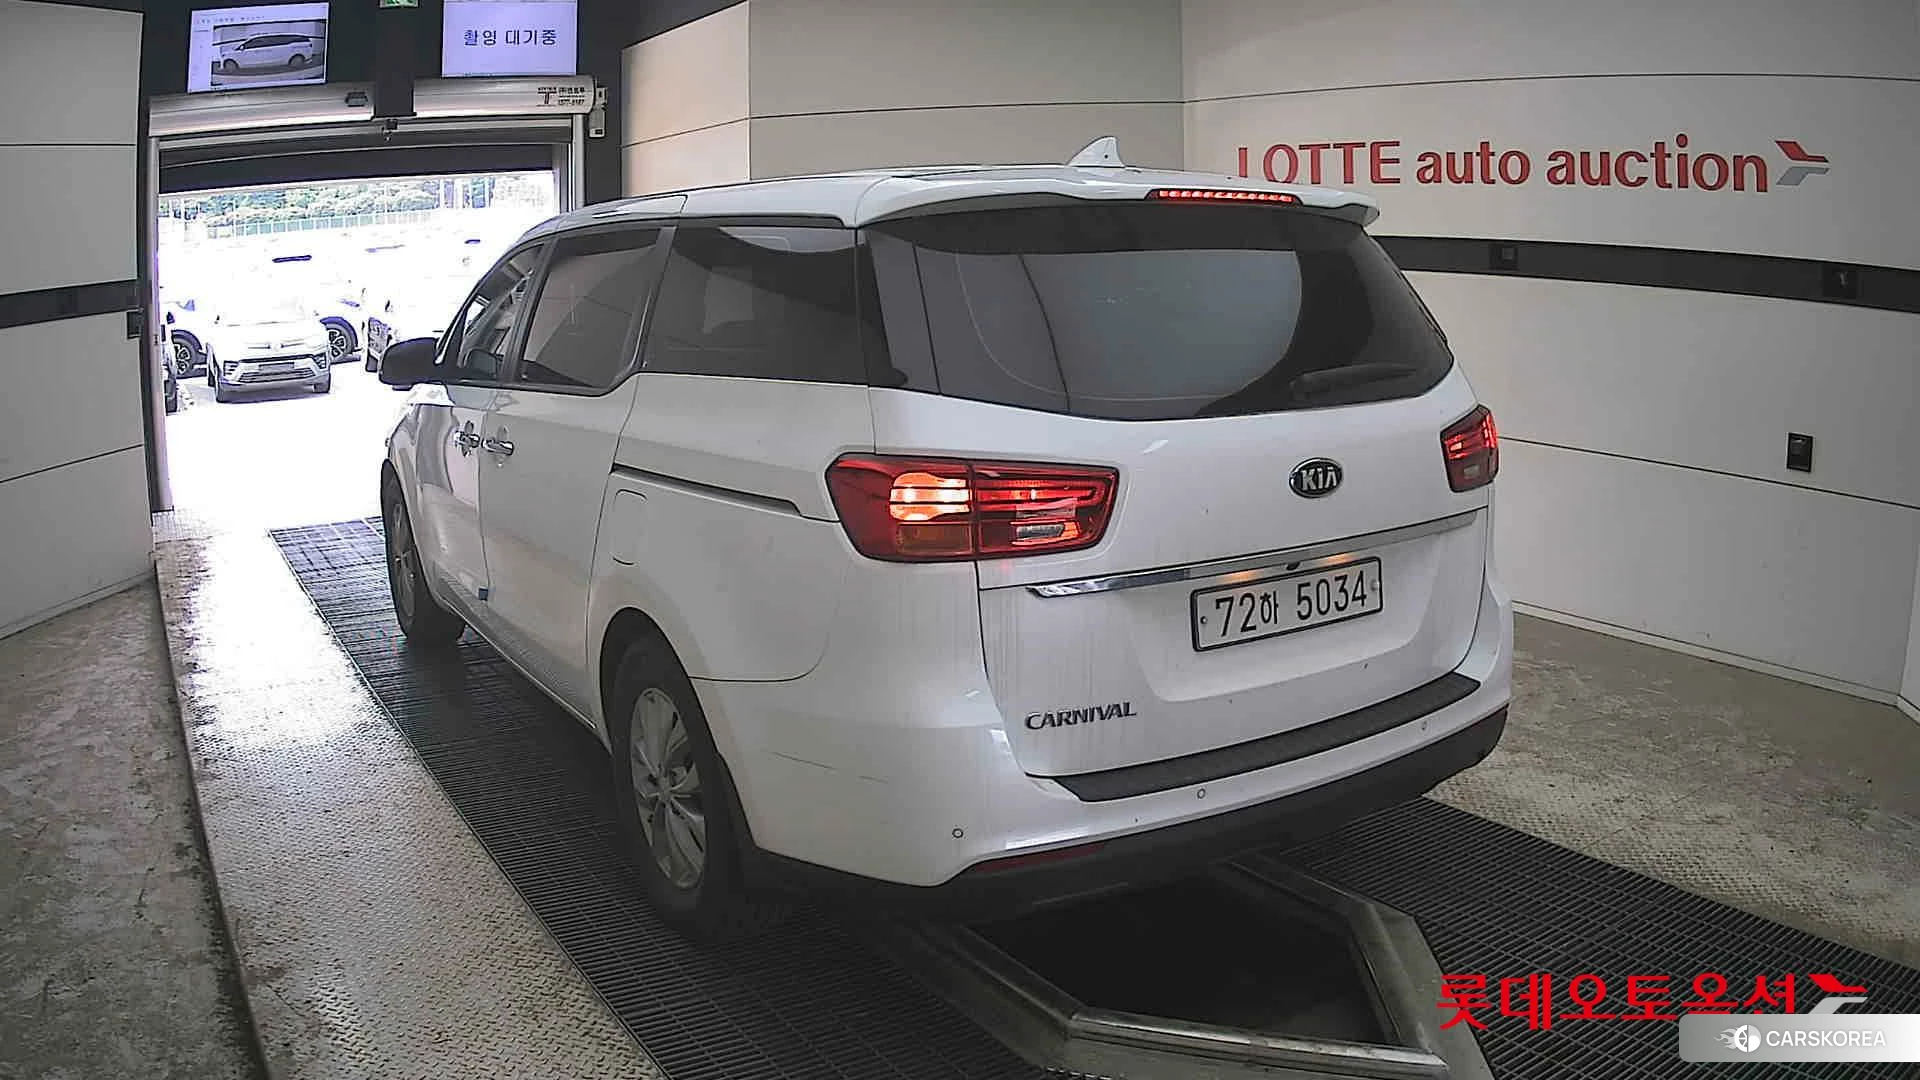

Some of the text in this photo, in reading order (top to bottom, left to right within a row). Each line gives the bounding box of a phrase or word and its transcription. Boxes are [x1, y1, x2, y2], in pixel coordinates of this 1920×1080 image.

[505, 29, 557, 46] 대기중
[1416, 141, 1530, 185] auto
[1546, 133, 1768, 193] auction
[1215, 570, 1367, 637] 72하 5034
[1025, 702, 1137, 730] CARNIVAL
